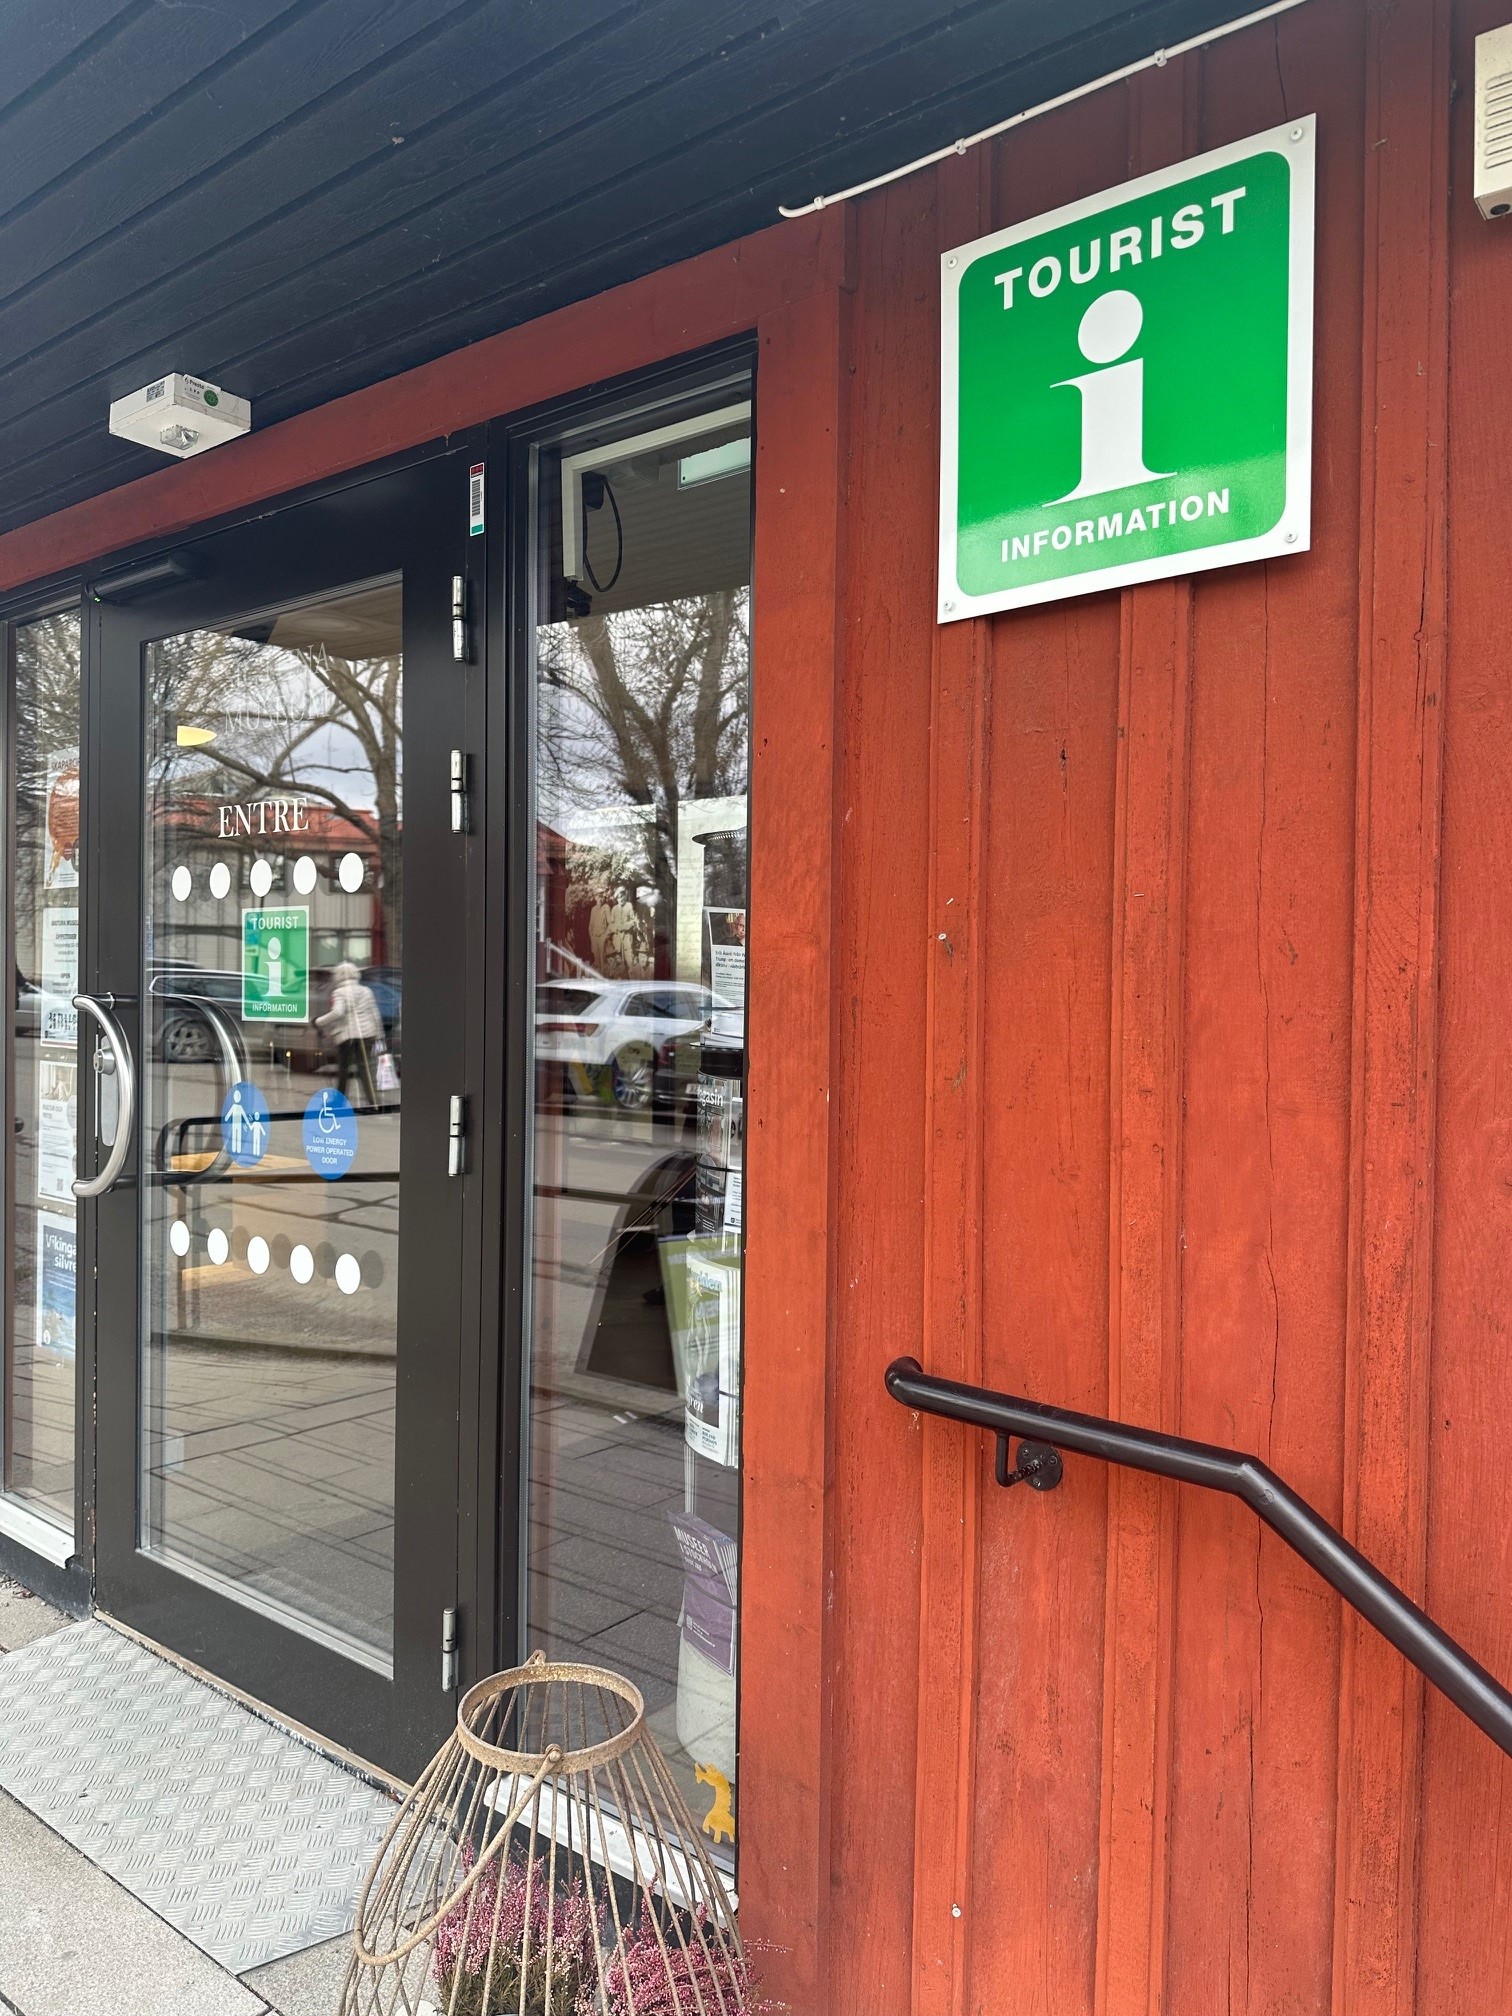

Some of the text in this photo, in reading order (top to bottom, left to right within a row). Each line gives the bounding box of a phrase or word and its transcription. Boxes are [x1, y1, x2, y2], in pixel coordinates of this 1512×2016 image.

[994, 187, 1247, 310] TOURIST
[1000, 488, 1230, 563] INFORMATION
[218, 797, 309, 838] ENTRE
[252, 916, 299, 930] TOURIST
[252, 1003, 298, 1012] INFORMATION
[313, 1136, 347, 1147] LOW ENERGY
[306, 1146, 354, 1157] POWER OPERATED
